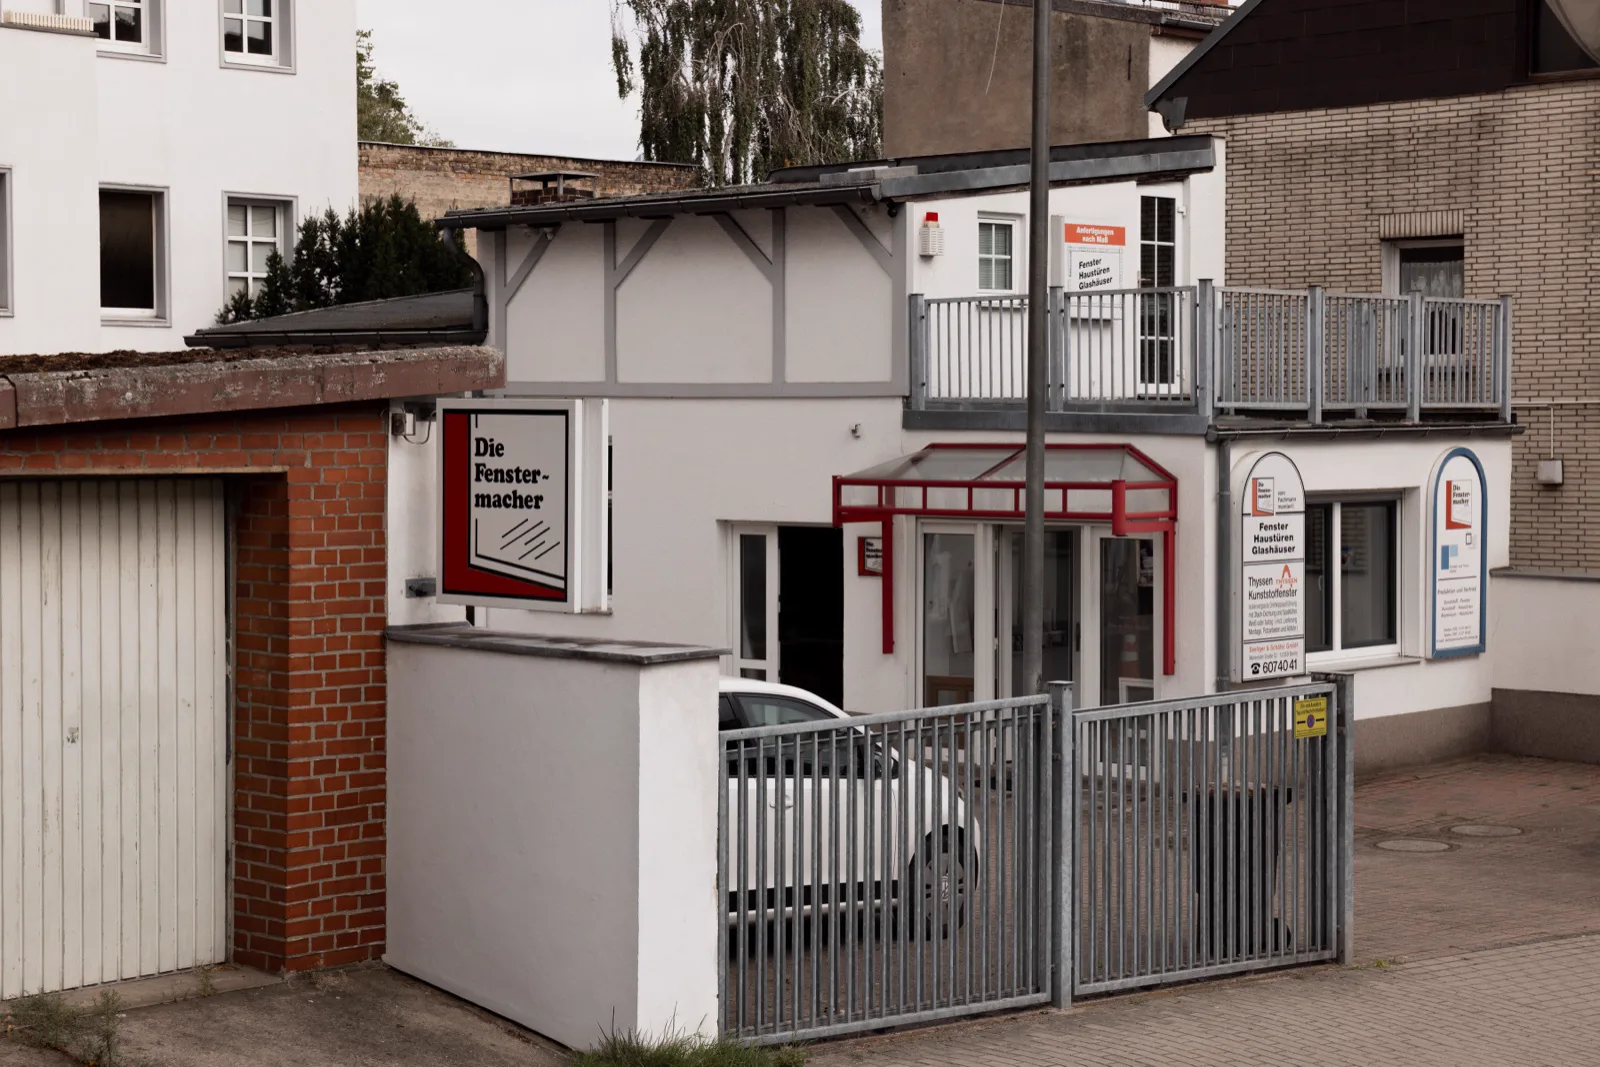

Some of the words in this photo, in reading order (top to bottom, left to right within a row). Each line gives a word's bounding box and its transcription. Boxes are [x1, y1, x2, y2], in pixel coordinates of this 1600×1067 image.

[1076, 226, 1114, 236] Anfertigungen
[1079, 258, 1102, 269] Fenster
[1079, 266, 1110, 280] Haustüren
[1079, 276, 1112, 290] Glashäuser
[474, 437, 504, 458] Die
[474, 490, 544, 510] macher
[1260, 522, 1288, 532] Fenster
[1254, 533, 1294, 544] Haustüren
[1252, 545, 1296, 555] Glashäuser
[1248, 576, 1274, 588] Thyssen
